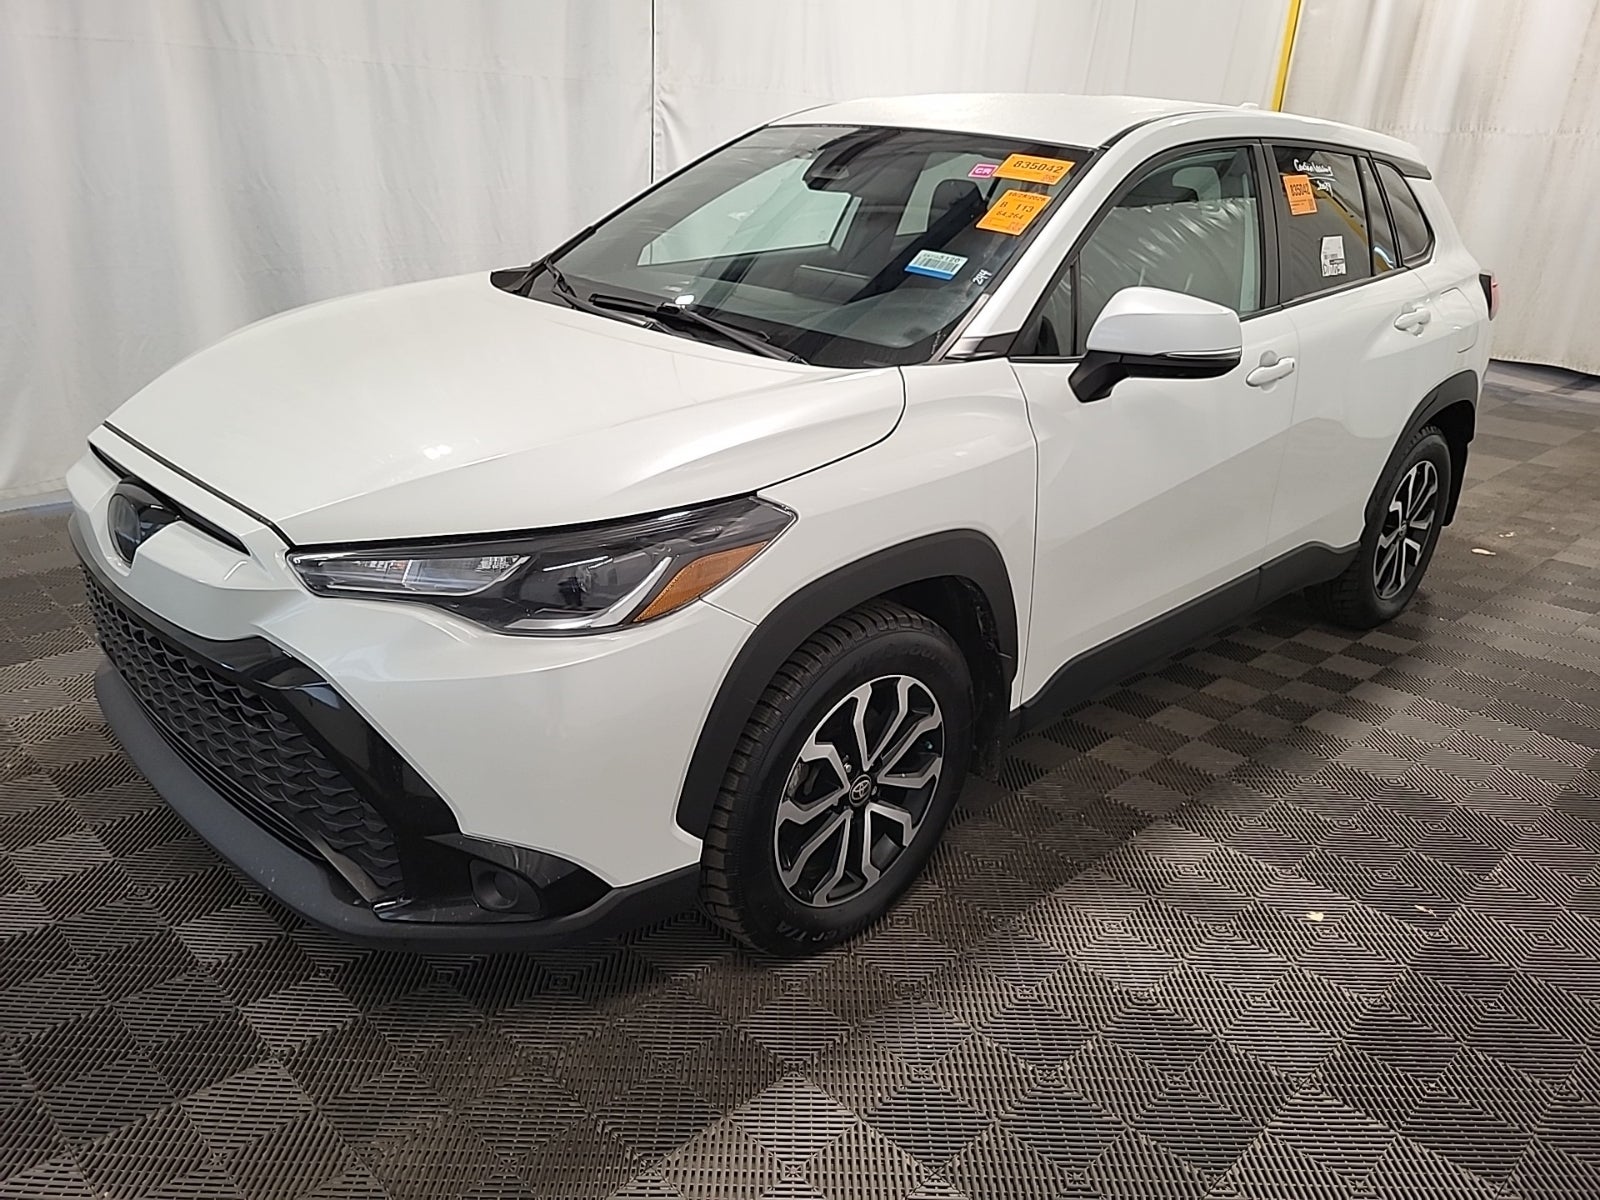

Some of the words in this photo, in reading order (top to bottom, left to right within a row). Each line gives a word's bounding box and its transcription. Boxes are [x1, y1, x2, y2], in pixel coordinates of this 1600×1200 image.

[974, 167, 991, 175] CR
[1013, 160, 1064, 174] 835042
[1015, 203, 1035, 213] 113
